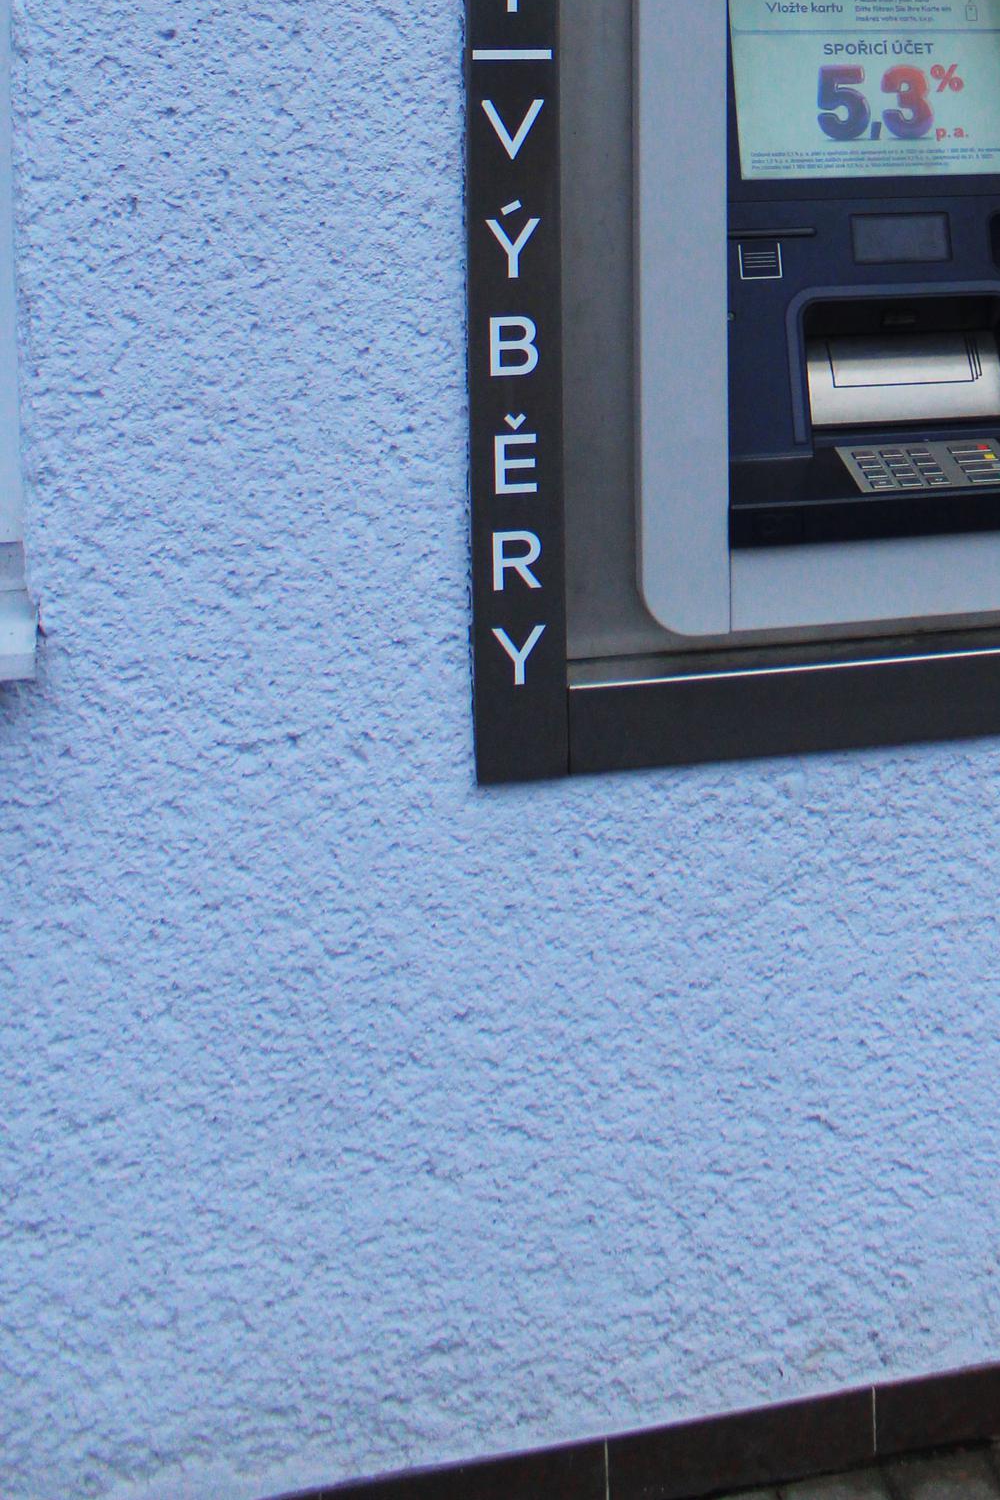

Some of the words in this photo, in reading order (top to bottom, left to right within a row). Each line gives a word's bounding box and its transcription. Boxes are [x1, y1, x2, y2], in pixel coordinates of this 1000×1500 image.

[765, 2, 809, 13] Vložte
[811, 2, 844, 13] kartu
[823, 39, 888, 56] SPOŘICÍ
[891, 38, 934, 55] ÚČET
[481, 99, 546, 686] VÝBĚRY
